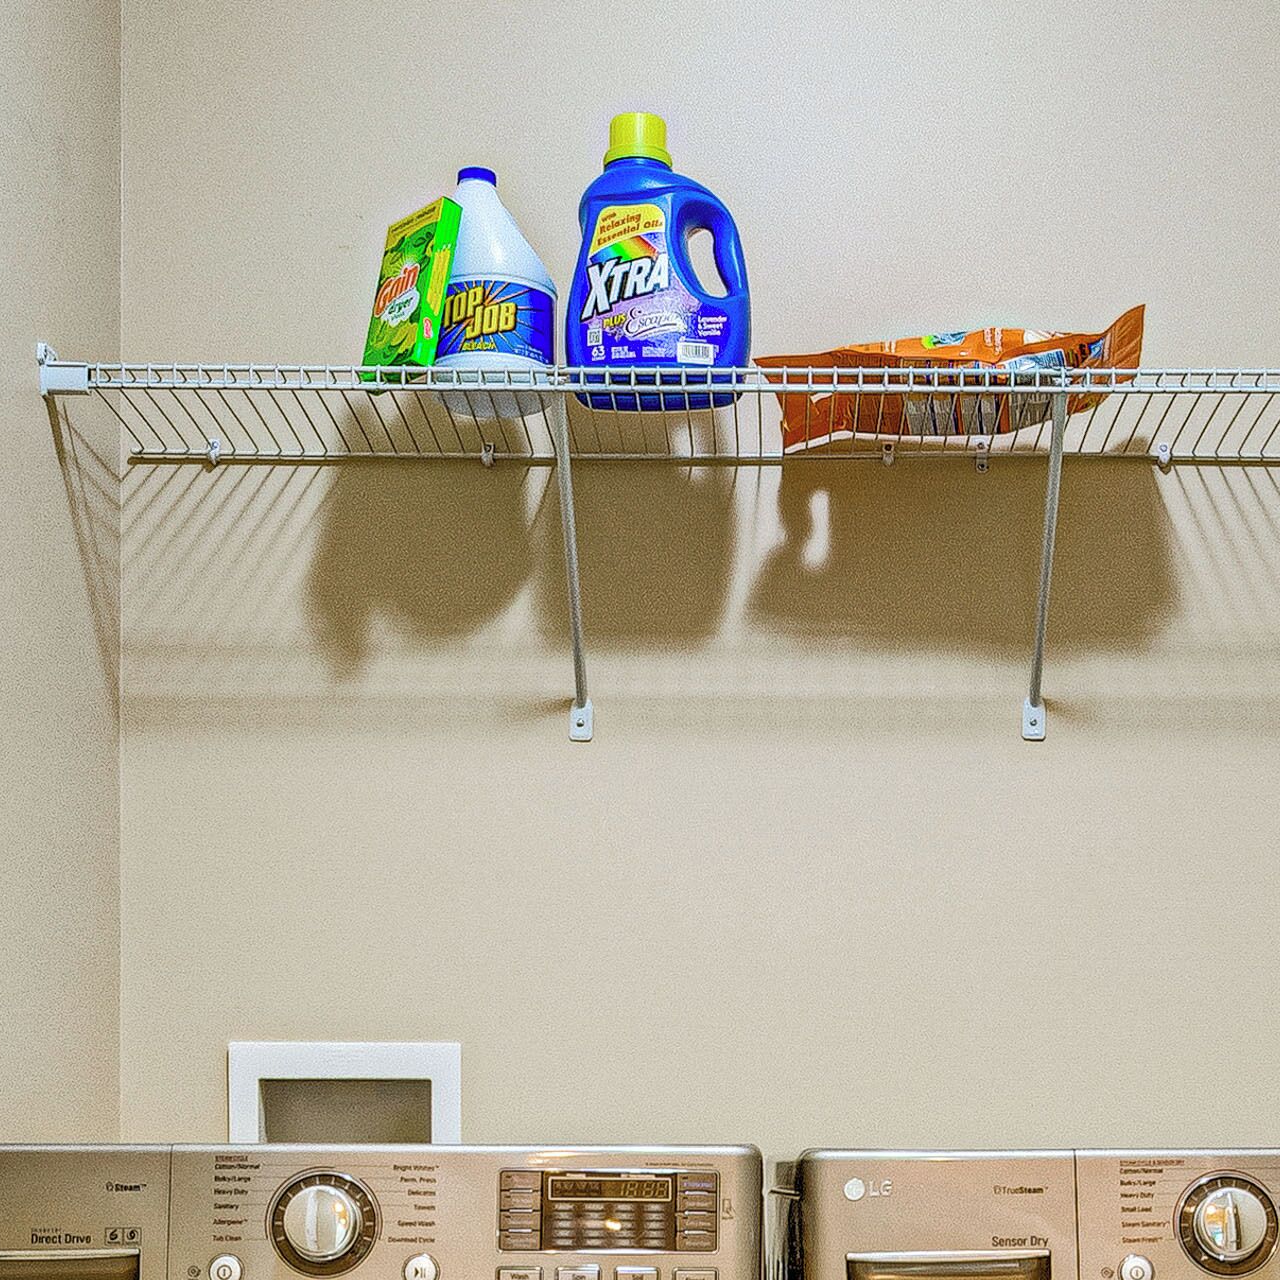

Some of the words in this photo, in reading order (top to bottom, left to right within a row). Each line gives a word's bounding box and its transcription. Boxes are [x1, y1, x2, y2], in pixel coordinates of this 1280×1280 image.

[597, 223, 641, 246] Essential
[599, 213, 642, 235] Relaxing
[373, 264, 420, 317] Gain
[581, 252, 670, 321] XTRA
[443, 286, 484, 329] TOP
[465, 302, 517, 340] JOB
[602, 312, 627, 329] PLUS
[591, 345, 606, 357] 63
[869, 1180, 893, 1197] LG
[31, 1233, 63, 1246] Direct
[64, 1233, 93, 1245] Drive
[992, 1235, 1028, 1247] Sensor
[1030, 1235, 1050, 1248] Dry
